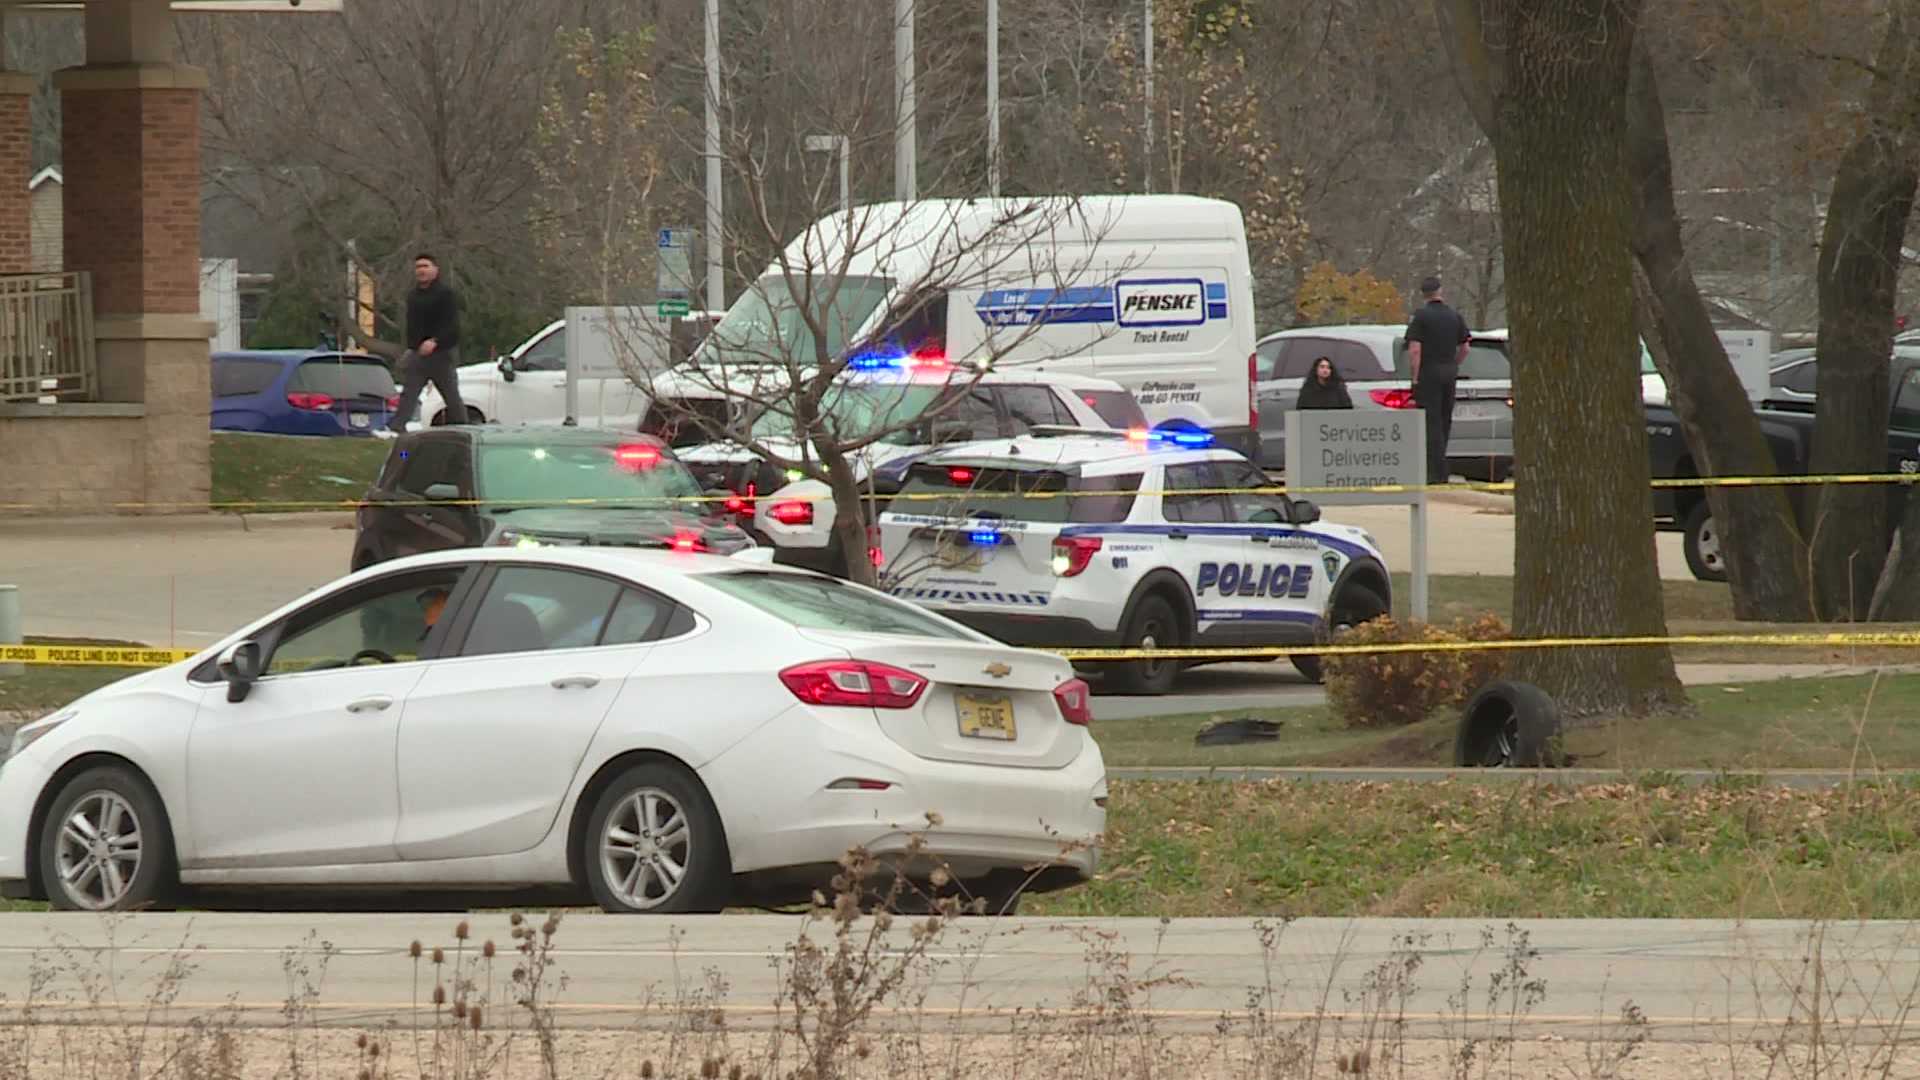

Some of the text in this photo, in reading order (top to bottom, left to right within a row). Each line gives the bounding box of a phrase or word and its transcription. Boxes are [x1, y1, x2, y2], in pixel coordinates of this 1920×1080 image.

[1123, 294, 1198, 311] PENSKE
[1133, 329, 1189, 343] Truck Rental
[1319, 422, 1402, 442] Services &
[1322, 449, 1400, 467] Deliveries
[1325, 473, 1397, 488] Entrance
[1197, 562, 1313, 598] POLICE
[6, 648, 37, 660] CROSS
[48, 649, 80, 661] POLICE
[83, 650, 103, 662] LINE
[106, 651, 119, 662] DO
[121, 651, 139, 662] NOT
[142, 651, 173, 663] CROSS
